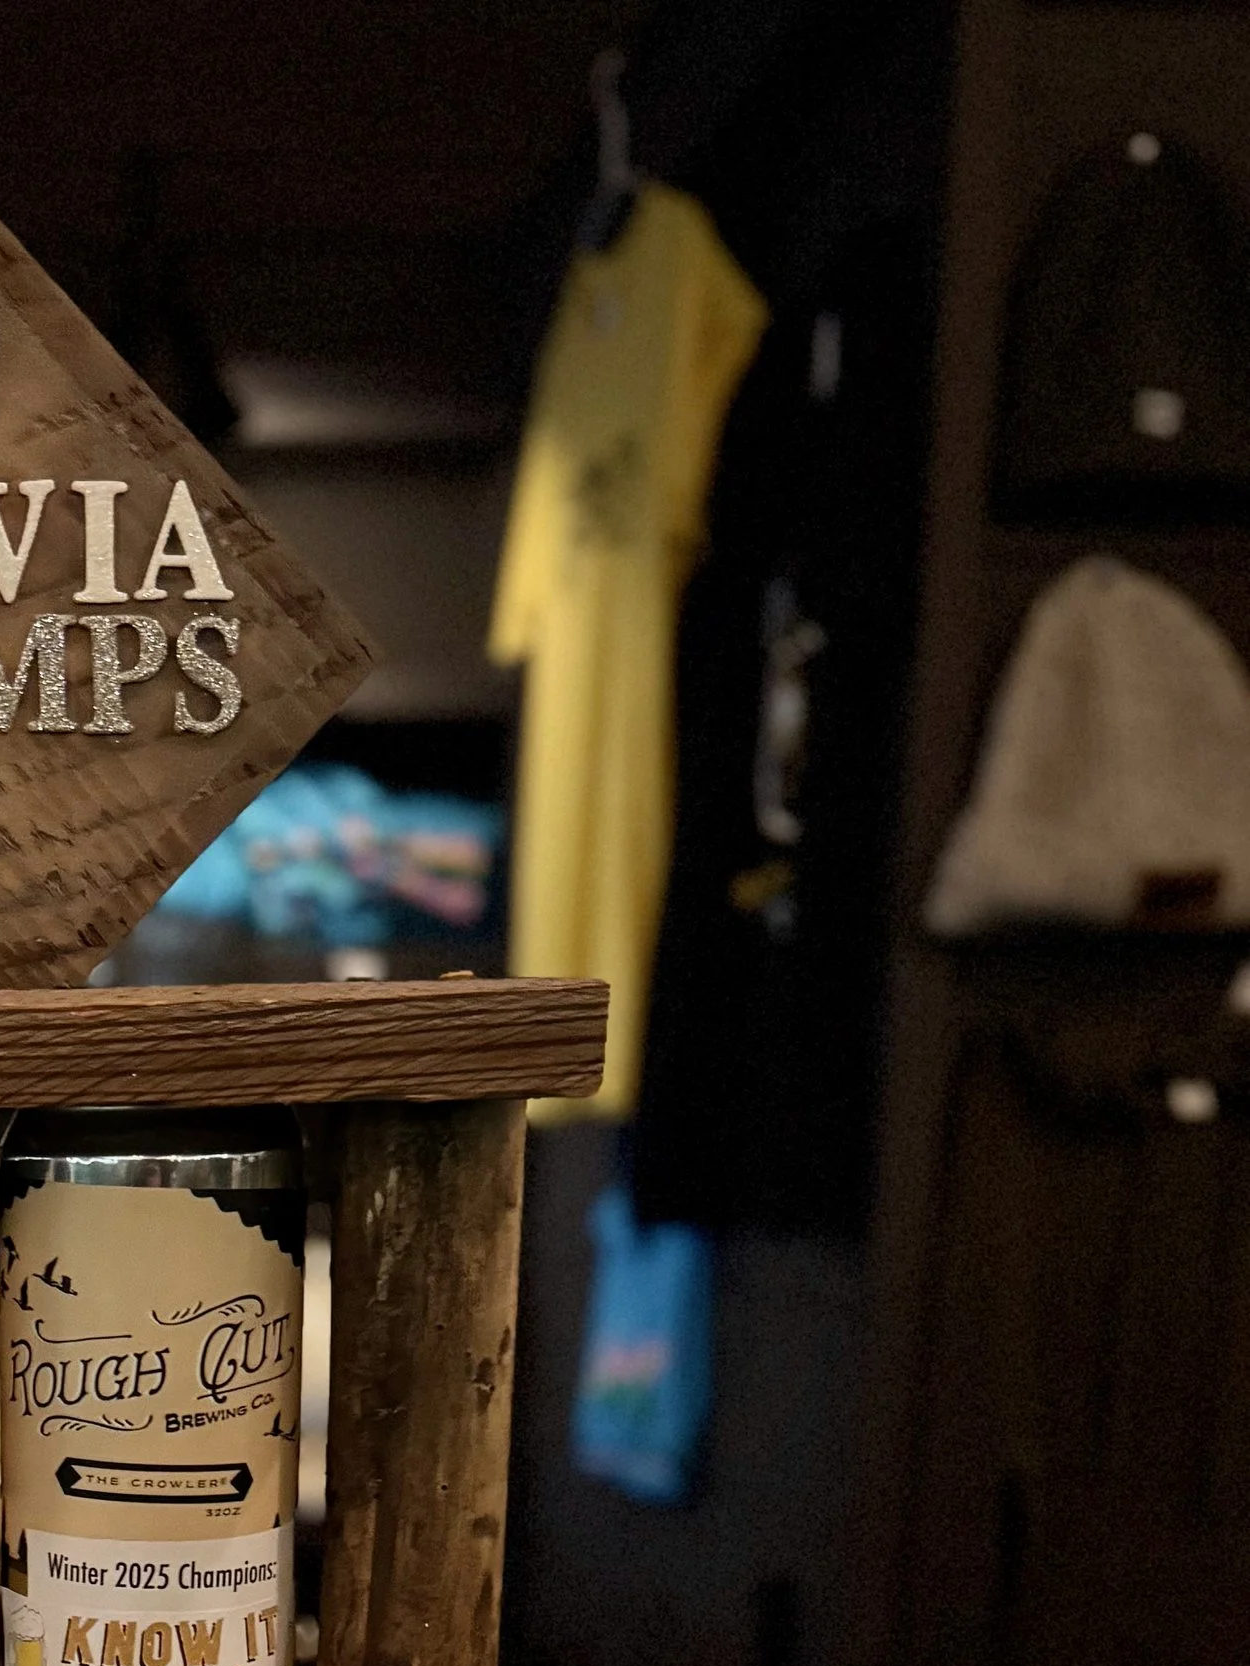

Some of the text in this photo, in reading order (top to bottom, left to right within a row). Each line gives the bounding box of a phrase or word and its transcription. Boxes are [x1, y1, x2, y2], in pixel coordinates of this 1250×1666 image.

[9, 1339, 170, 1416] ROUGH
[166, 1406, 247, 1433] BREWING
[86, 1475, 119, 1486] THE
[48, 1552, 277, 1592] Winter 2025 Champions:
[244, 1605, 278, 1663] IT
